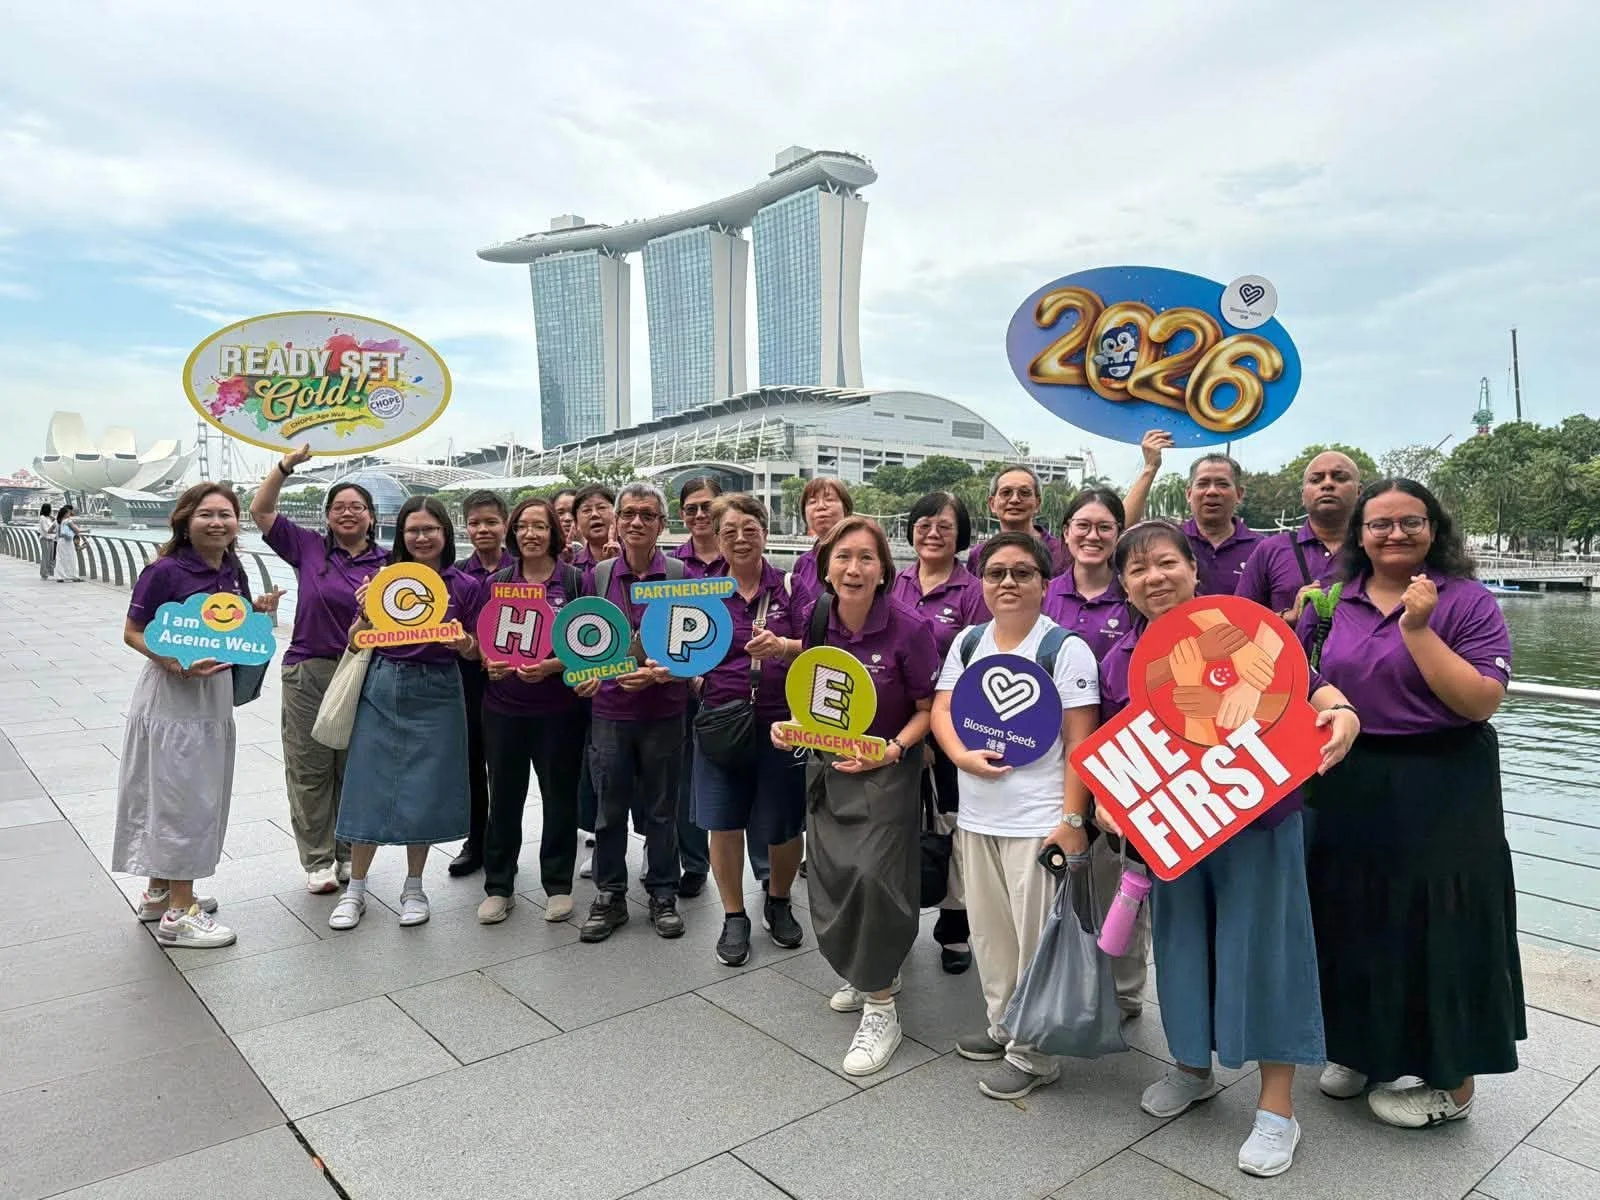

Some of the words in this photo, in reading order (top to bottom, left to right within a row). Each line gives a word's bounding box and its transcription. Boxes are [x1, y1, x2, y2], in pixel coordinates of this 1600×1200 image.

[220, 345, 331, 377] READY
[340, 350, 402, 381] SET
[1028, 287, 1283, 432] 2026
[254, 372, 369, 421] Gold!
[370, 396, 401, 410] CHOPE
[382, 576, 435, 627] C
[494, 586, 543, 599] HEALTH
[634, 580, 734, 600] PARTNERSHIP
[162, 611, 169, 625] I
[172, 615, 200, 629] am
[358, 625, 459, 645] COORDINATION
[494, 604, 544, 659] H
[566, 612, 620, 663] O
[667, 604, 718, 663] P
[566, 660, 635, 683] OUTREACH
[809, 663, 855, 731] E
[963, 717, 1005, 739] Blossom
[1005, 730, 1037, 748] Seeds
[1081, 709, 1191, 810] WE
[1127, 716, 1292, 870] FIRST
